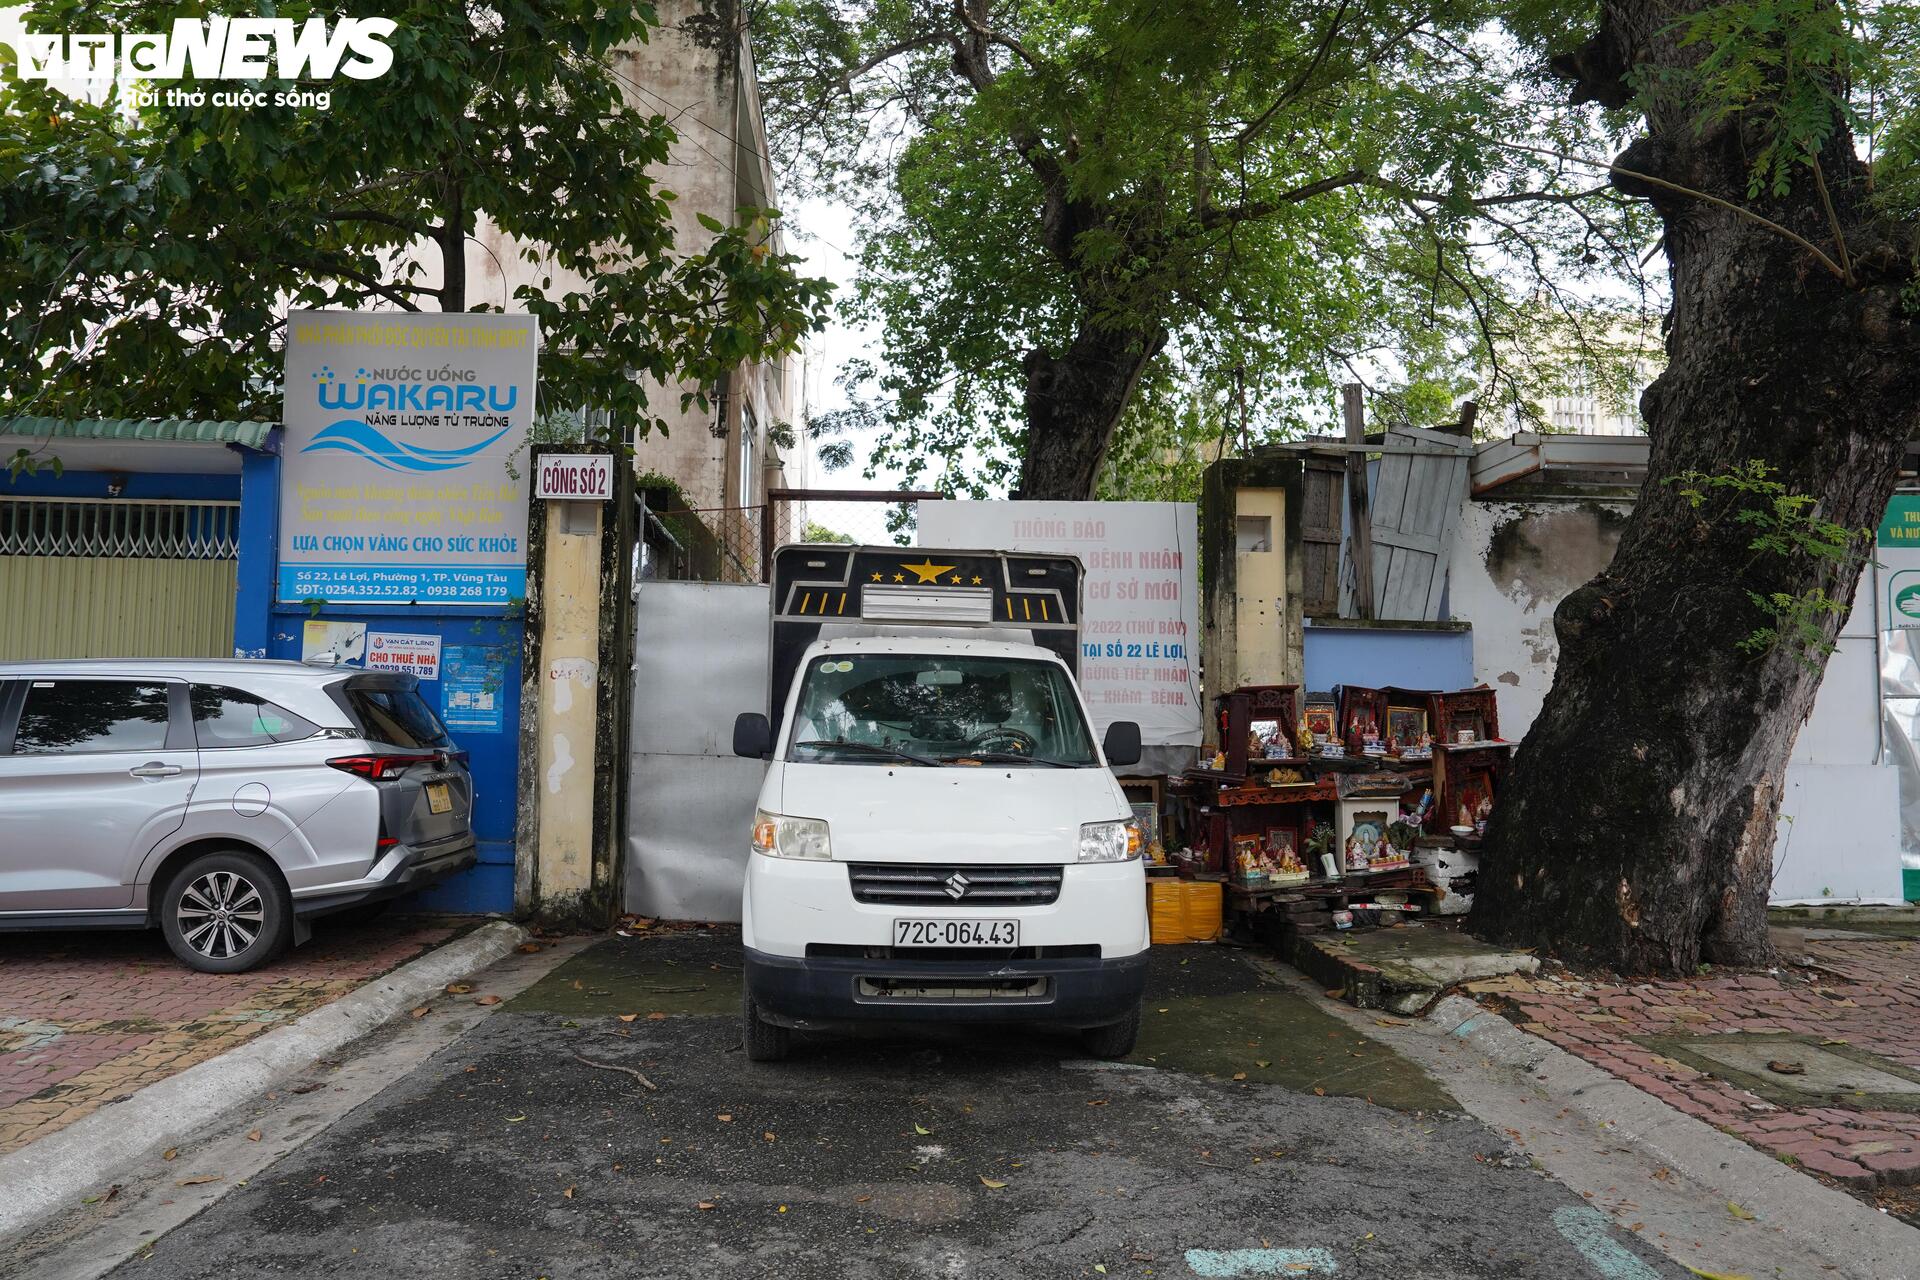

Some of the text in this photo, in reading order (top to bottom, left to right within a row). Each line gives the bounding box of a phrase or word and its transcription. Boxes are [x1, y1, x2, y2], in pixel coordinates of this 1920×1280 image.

[373, 364, 476, 382] NƯỚC UỐNG
[319, 378, 518, 412] WAKARU
[365, 412, 509, 429] NĂNG LƯỢNG TỪ TRƯỜNG
[543, 459, 606, 494] CỔNG SỐ 2
[1013, 516, 1106, 538] THÔNG BÁO
[292, 533, 518, 554] LỰA CHỌN VÀNG CHO SỨC KHỎE
[1089, 548, 1183, 573] BỆNH NHÂN
[297, 571, 508, 584] Số 22, Lê Lợi, Phường 1, TP. Vũng Tàu
[296, 584, 323, 595] SĐT:
[325, 585, 417, 596] 0254.352.52.82
[427, 586, 457, 596] 0938
[460, 586, 482, 597] 268
[486, 586, 508, 597] 179
[1089, 577, 1178, 601] CƠ SỞ MỚI
[1126, 618, 1155, 636] (THỨ
[370, 652, 388, 663] CHO
[391, 652, 414, 664] THUÊ
[417, 653, 436, 665] NHÀ
[1106, 639, 1123, 657] SỐ
[1127, 644, 1142, 658] 22
[1146, 641, 1160, 658] LÊ
[1153, 665, 1187, 685] NHẬN
[899, 921, 1015, 944] 72C-064.43
